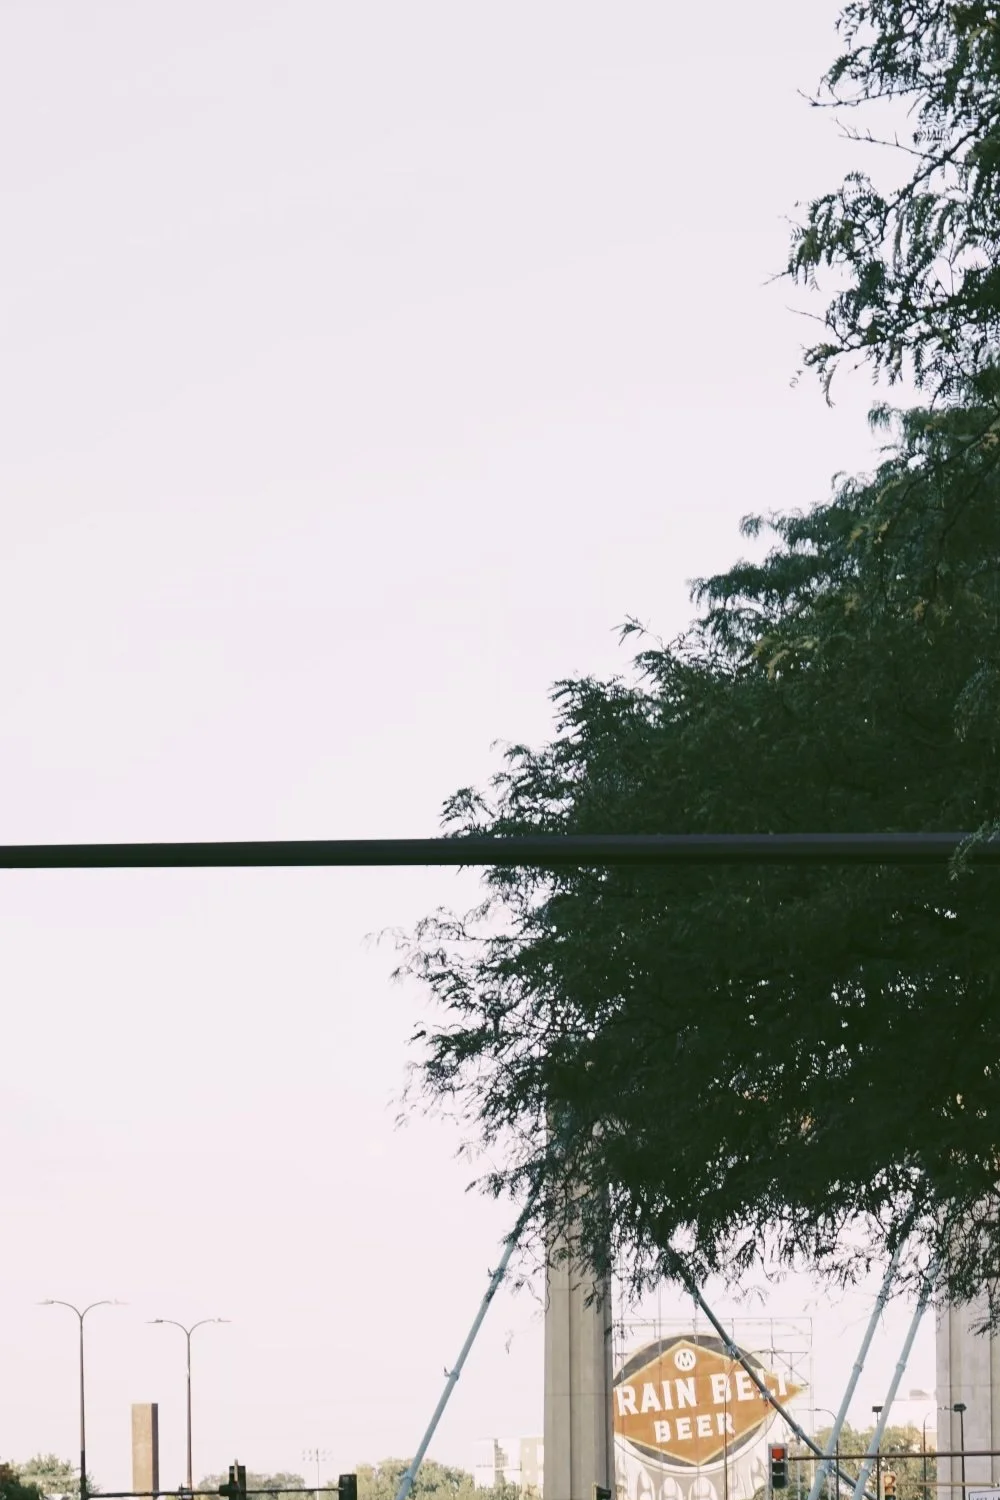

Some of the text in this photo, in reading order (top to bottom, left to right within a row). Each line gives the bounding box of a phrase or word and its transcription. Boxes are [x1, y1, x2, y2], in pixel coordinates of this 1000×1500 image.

[615, 1370, 788, 1415] RAIN BELT
[654, 1413, 735, 1443] BEER
